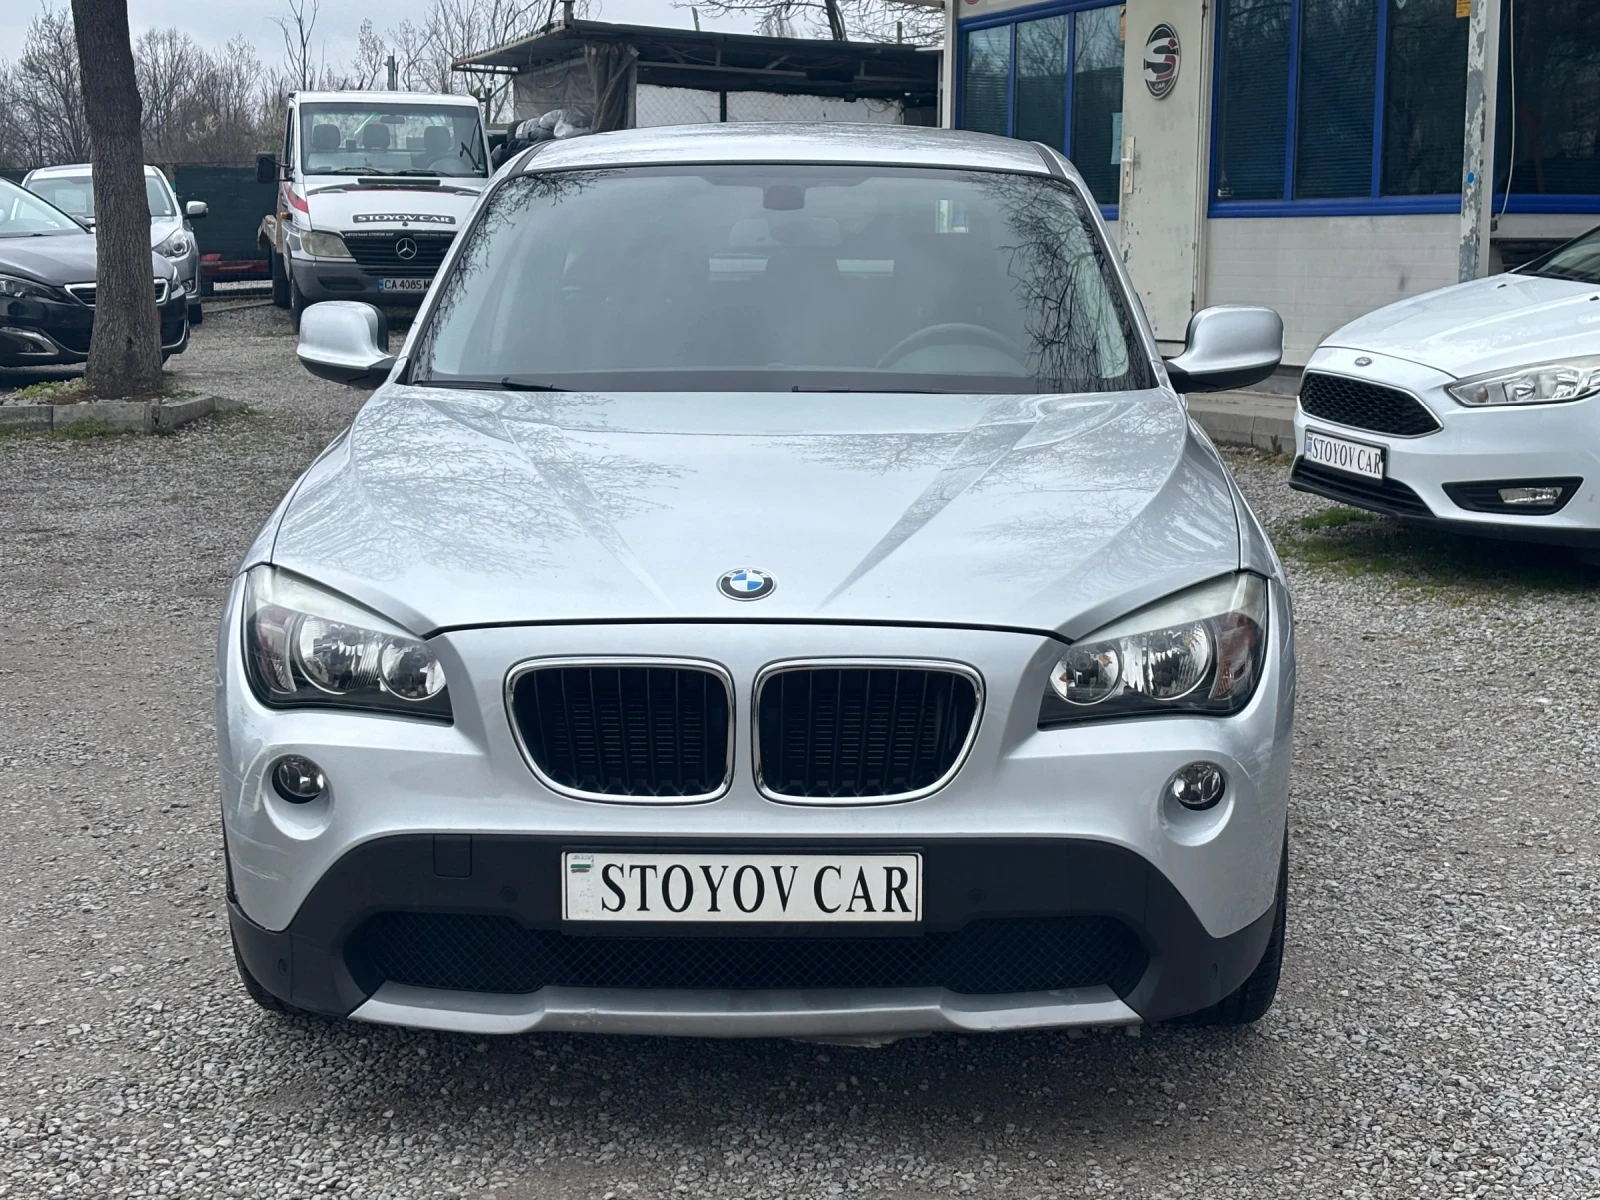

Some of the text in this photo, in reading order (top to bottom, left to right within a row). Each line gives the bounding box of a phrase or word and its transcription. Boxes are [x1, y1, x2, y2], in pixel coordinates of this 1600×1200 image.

[384, 279, 433, 290] CA 4085 M
[1312, 437, 1381, 475] STOYOV CAR
[601, 863, 912, 913] STOYOV CAR
